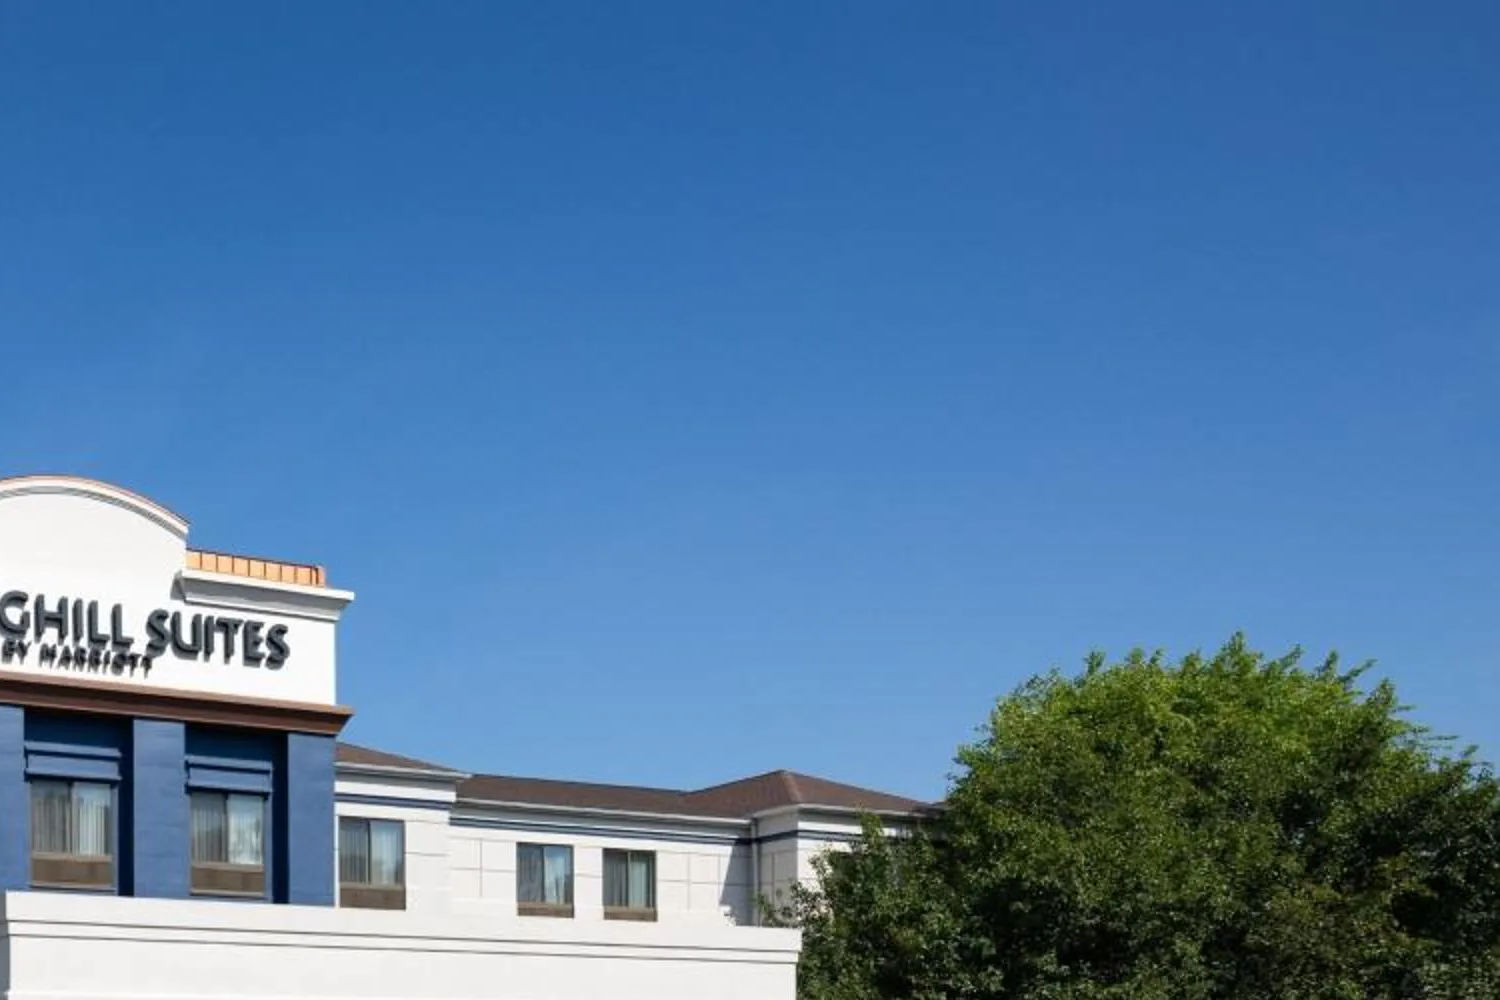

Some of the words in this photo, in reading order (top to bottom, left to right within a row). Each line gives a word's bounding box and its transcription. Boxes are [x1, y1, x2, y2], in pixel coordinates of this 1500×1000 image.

[1, 638, 31, 664] BY
[38, 643, 153, 679] MARRIOTT
[145, 608, 290, 670] SUITES
